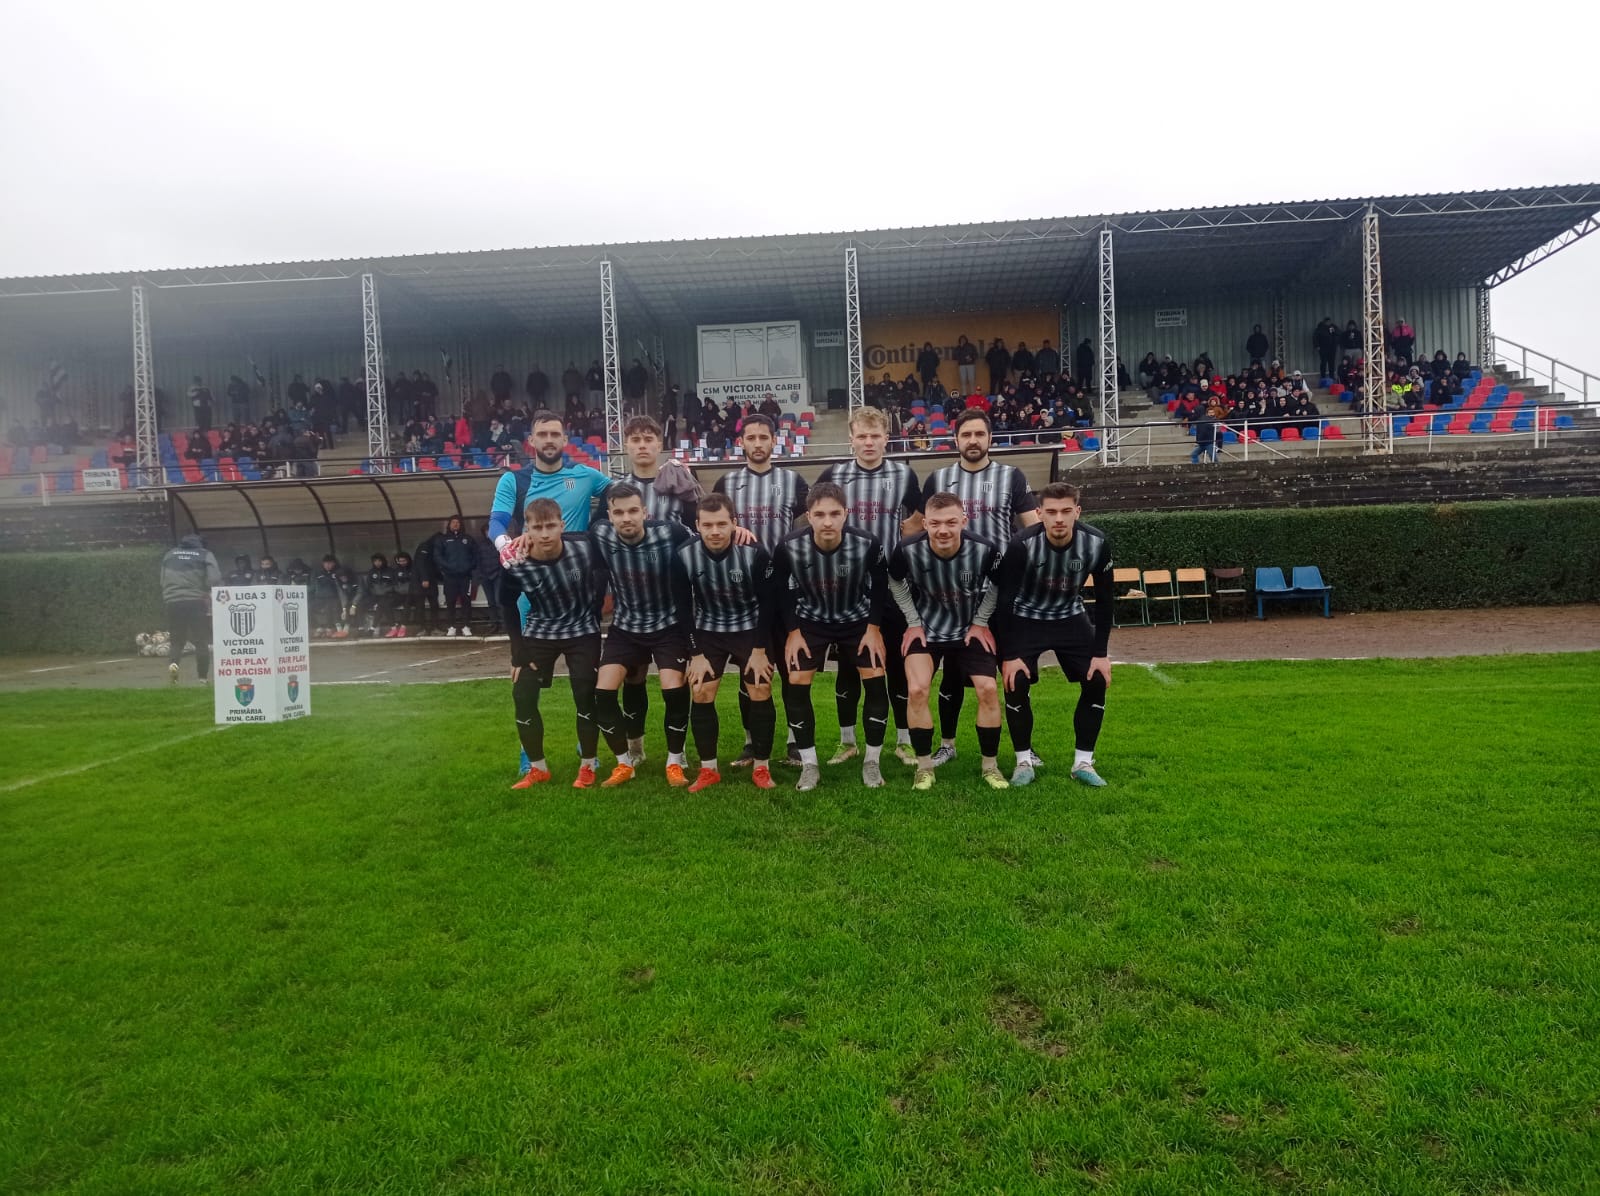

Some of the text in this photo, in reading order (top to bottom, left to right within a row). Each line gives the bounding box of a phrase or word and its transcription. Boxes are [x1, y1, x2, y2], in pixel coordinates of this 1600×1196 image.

[723, 383, 772, 393] VICTORIA
[775, 383, 801, 391] CAREI
[235, 592, 266, 600] LIGA 3
[286, 591, 299, 599] LIGA
[223, 638, 264, 646] VICTORIA
[221, 657, 268, 666] FAIR PLAY
[279, 655, 305, 664] FAIR PLAY
[235, 667, 271, 675] RACISM
